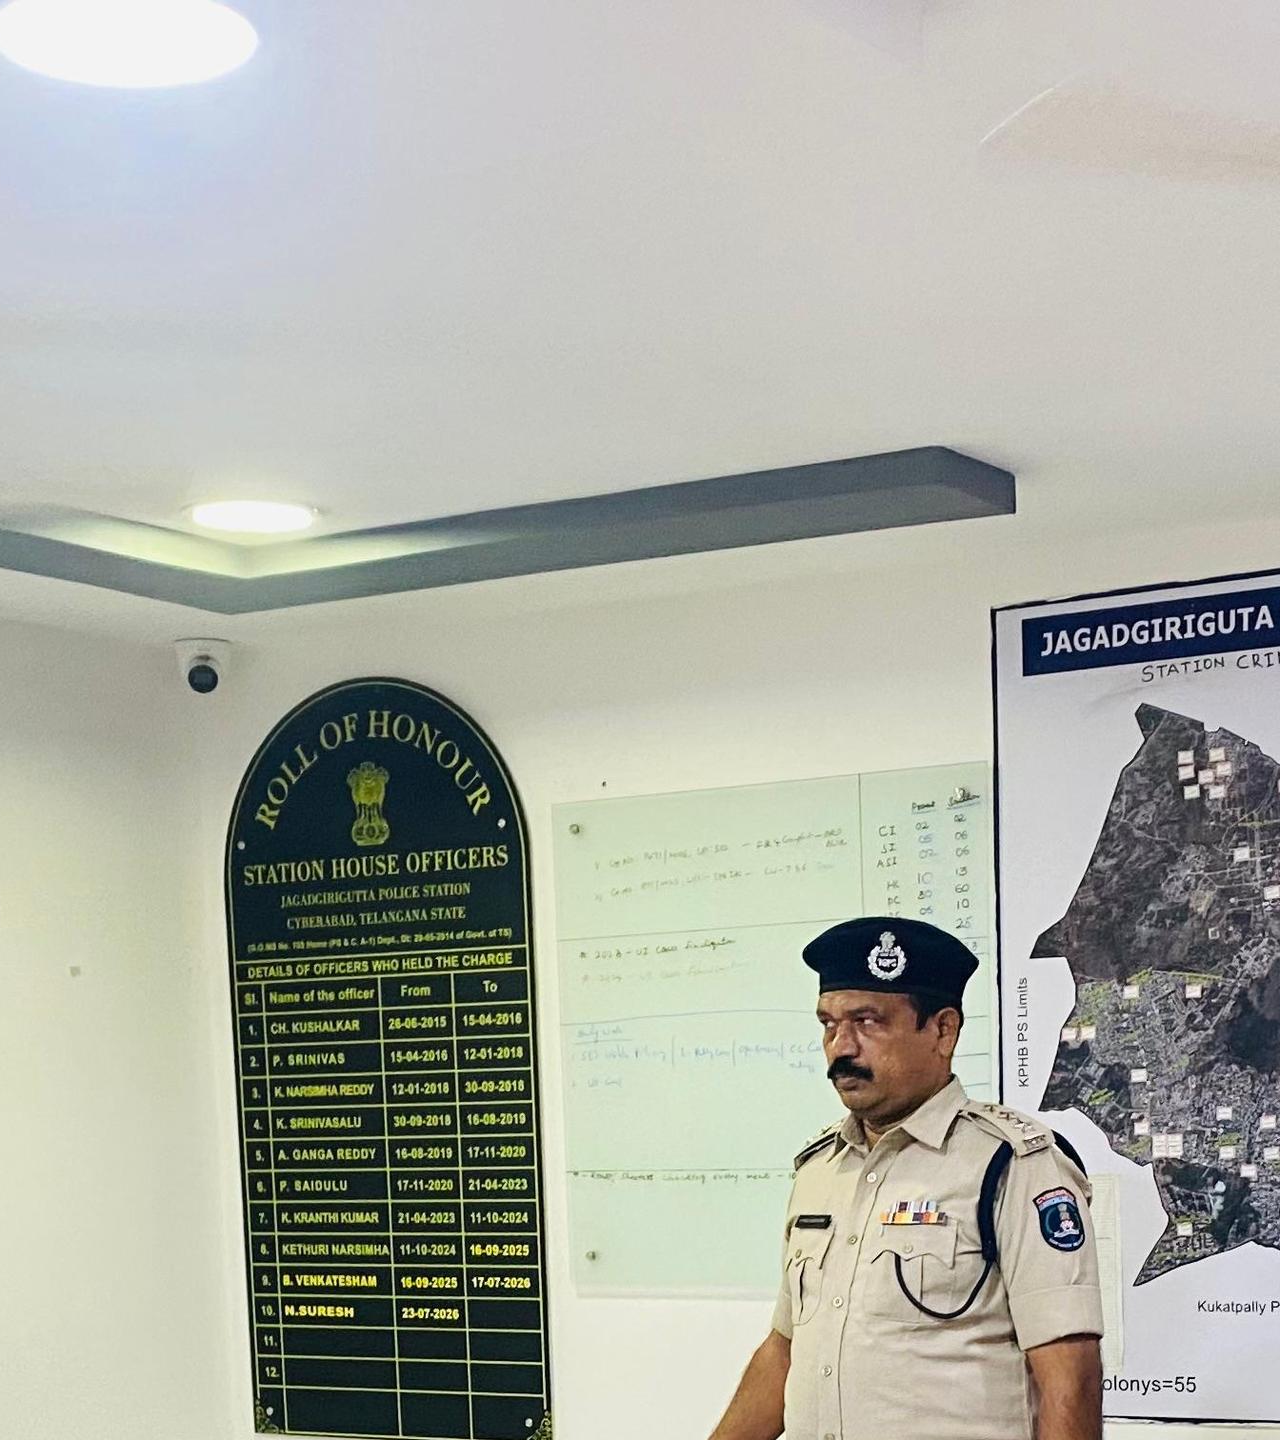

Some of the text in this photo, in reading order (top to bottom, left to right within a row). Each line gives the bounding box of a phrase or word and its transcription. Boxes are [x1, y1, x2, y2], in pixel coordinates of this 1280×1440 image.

[1041, 606, 1273, 658] JAGADGIRIGUTA
[1141, 657, 1225, 683] STATION
[255, 710, 491, 831] ROLL OF HONOUR
[243, 845, 508, 886] STATION HOUSE OFFICERS
[378, 886, 420, 901] POLICE
[423, 882, 471, 898] STATION
[360, 910, 427, 925] TELANGANA
[431, 906, 466, 920] STATE
[248, 952, 512, 979] DETAILS OF OFFICERS WHO HELD THE CHARGE
[270, 992, 300, 1004] Name
[303, 989, 315, 1002] of
[317, 989, 335, 1001] the
[338, 987, 375, 1000] officer
[401, 985, 431, 997] From
[482, 980, 498, 993] To
[248, 1025, 257, 1035] 1.
[271, 1022, 290, 1034] CH.
[292, 1020, 360, 1033] KUSHALKAR
[1018, 977, 1029, 1088] KPHB PS Limits
[249, 1056, 259, 1067] 2.
[272, 1055, 283, 1066] P.
[288, 1053, 345, 1066] SRINIVAS
[274, 1086, 285, 1097] K.
[340, 1084, 375, 1096] REDDY
[253, 1119, 263, 1130] 4.
[276, 1118, 287, 1129] K.
[290, 1116, 362, 1130] SRINIVASALU
[255, 1150, 265, 1162] 5.
[278, 1149, 289, 1160] A.
[292, 1149, 334, 1161] GANGA
[336, 1148, 377, 1160] REDDY
[467, 1146, 526, 1158] 17-11-2020
[279, 1180, 290, 1192] P.
[294, 1179, 348, 1192] SAIDULU
[397, 1179, 453, 1191] 17-11-2020
[468, 1178, 528, 1191] 21-04-2023
[258, 1211, 529, 1224] 7. K. KRANTHI KUMAR 21-04-2023 11-10-2024
[282, 1244, 329, 1256] KETHURI
[331, 1244, 390, 1256] NARSIMHA
[399, 1244, 456, 1256] 11-10-2024
[295, 1274, 377, 1287] VENKATESHAM
[471, 1276, 531, 1289] 17-07-2026
[261, 1305, 459, 1320] 10. N.SURESH 23-07-2026
[1197, 1299, 1266, 1316] Kukatpally
[264, 1335, 278, 1347] 11.
[265, 1366, 279, 1378] 12.
[1102, 1374, 1197, 1397] olonys=55
